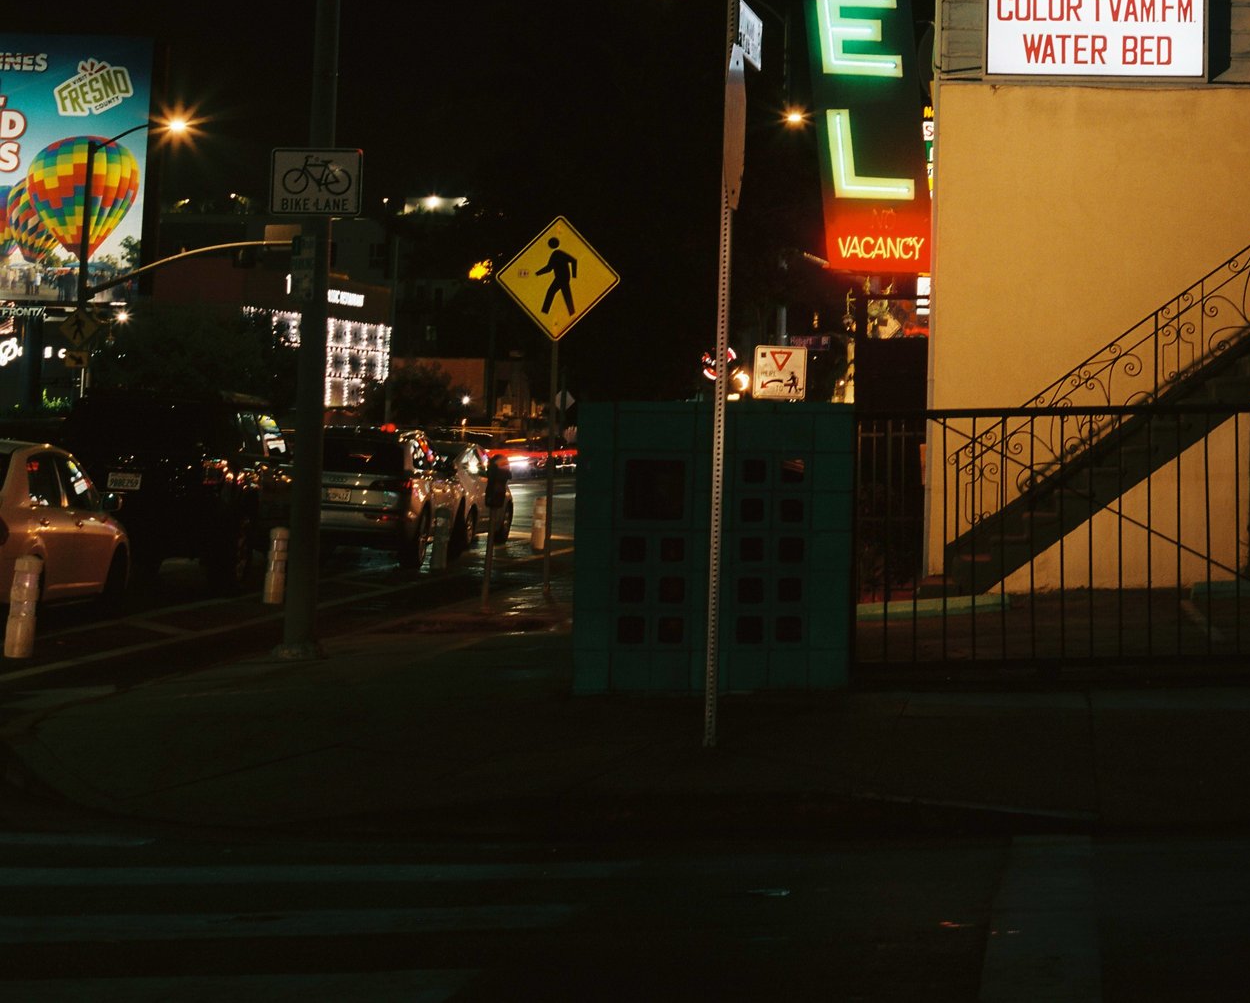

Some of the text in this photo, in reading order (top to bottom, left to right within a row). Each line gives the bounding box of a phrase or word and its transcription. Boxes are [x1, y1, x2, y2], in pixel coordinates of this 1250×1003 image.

[1022, 33, 1172, 66] WATER BED
[72, 74, 88, 85] VISIT
[57, 68, 130, 113] FRESNO
[94, 95, 120, 111] COUNTY
[281, 198, 349, 211] BIKE LANE
[838, 236, 925, 260] VACANCY
